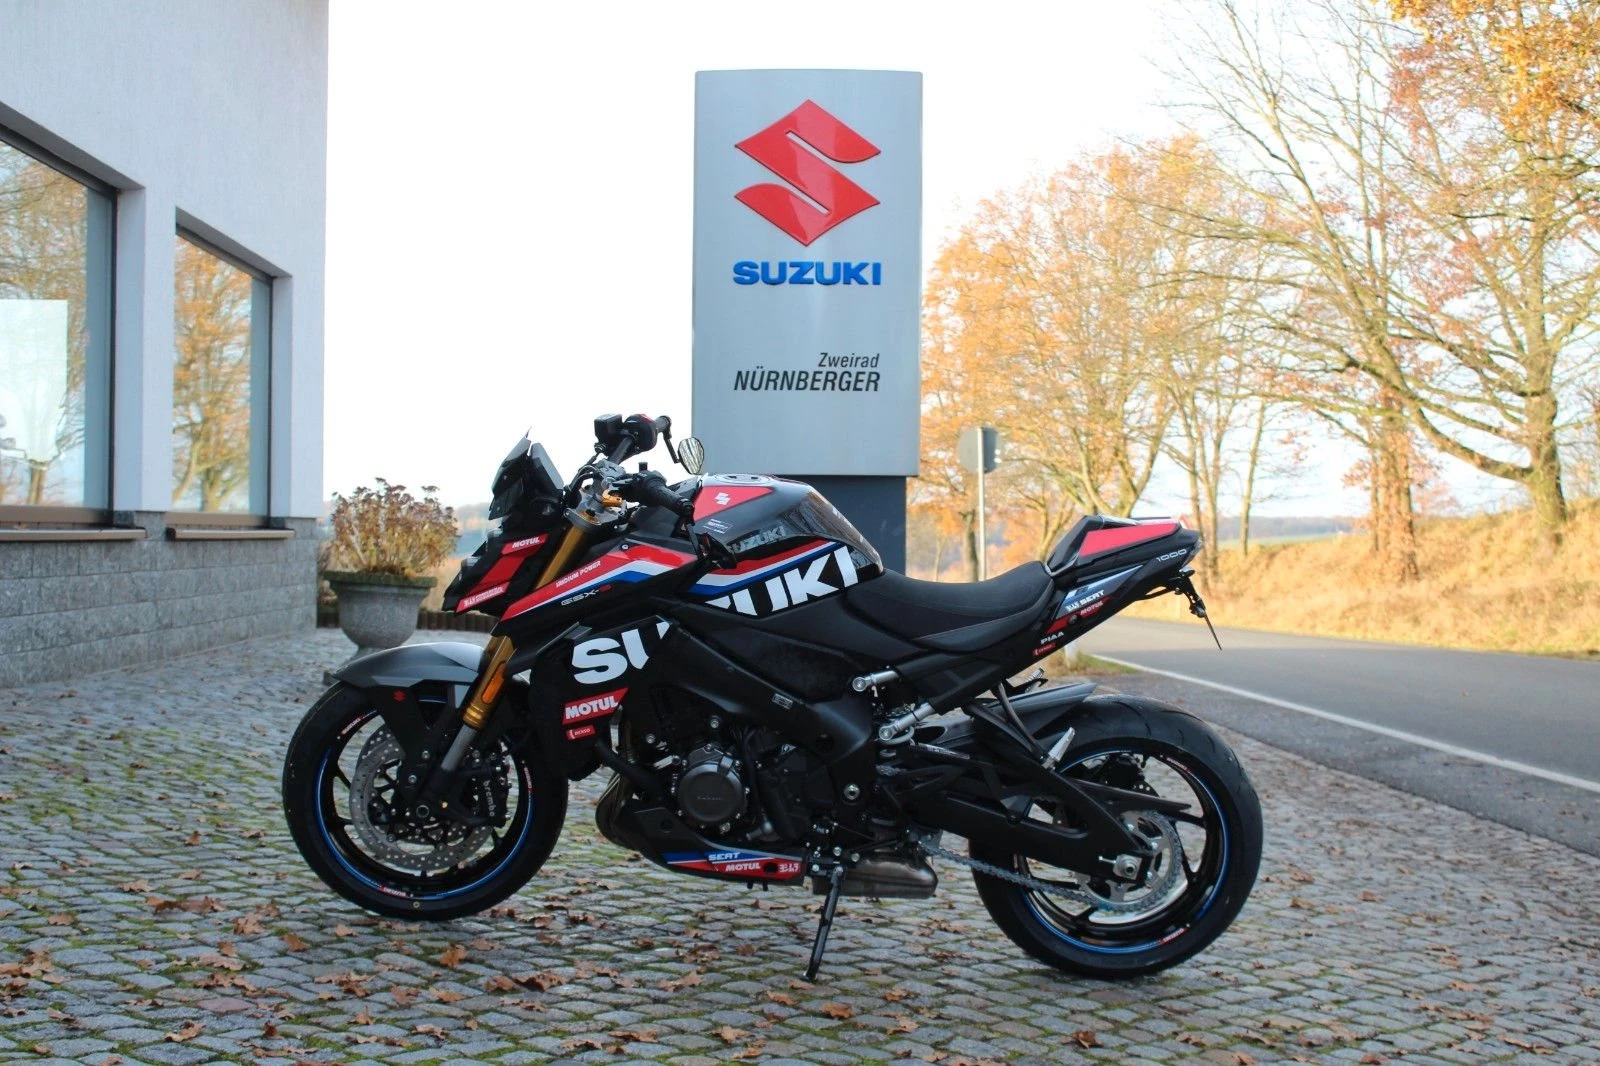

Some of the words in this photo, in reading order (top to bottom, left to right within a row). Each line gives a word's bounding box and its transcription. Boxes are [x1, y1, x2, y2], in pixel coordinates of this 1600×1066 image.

[733, 261, 882, 286] SUZUKI
[818, 352, 880, 368] Zweirad
[733, 365, 881, 392] NÜRNBERGER
[512, 536, 540, 549] MOTUL
[1156, 548, 1187, 562] 1000
[565, 695, 619, 720] MOTUL
[725, 862, 761, 872] MOTUL
